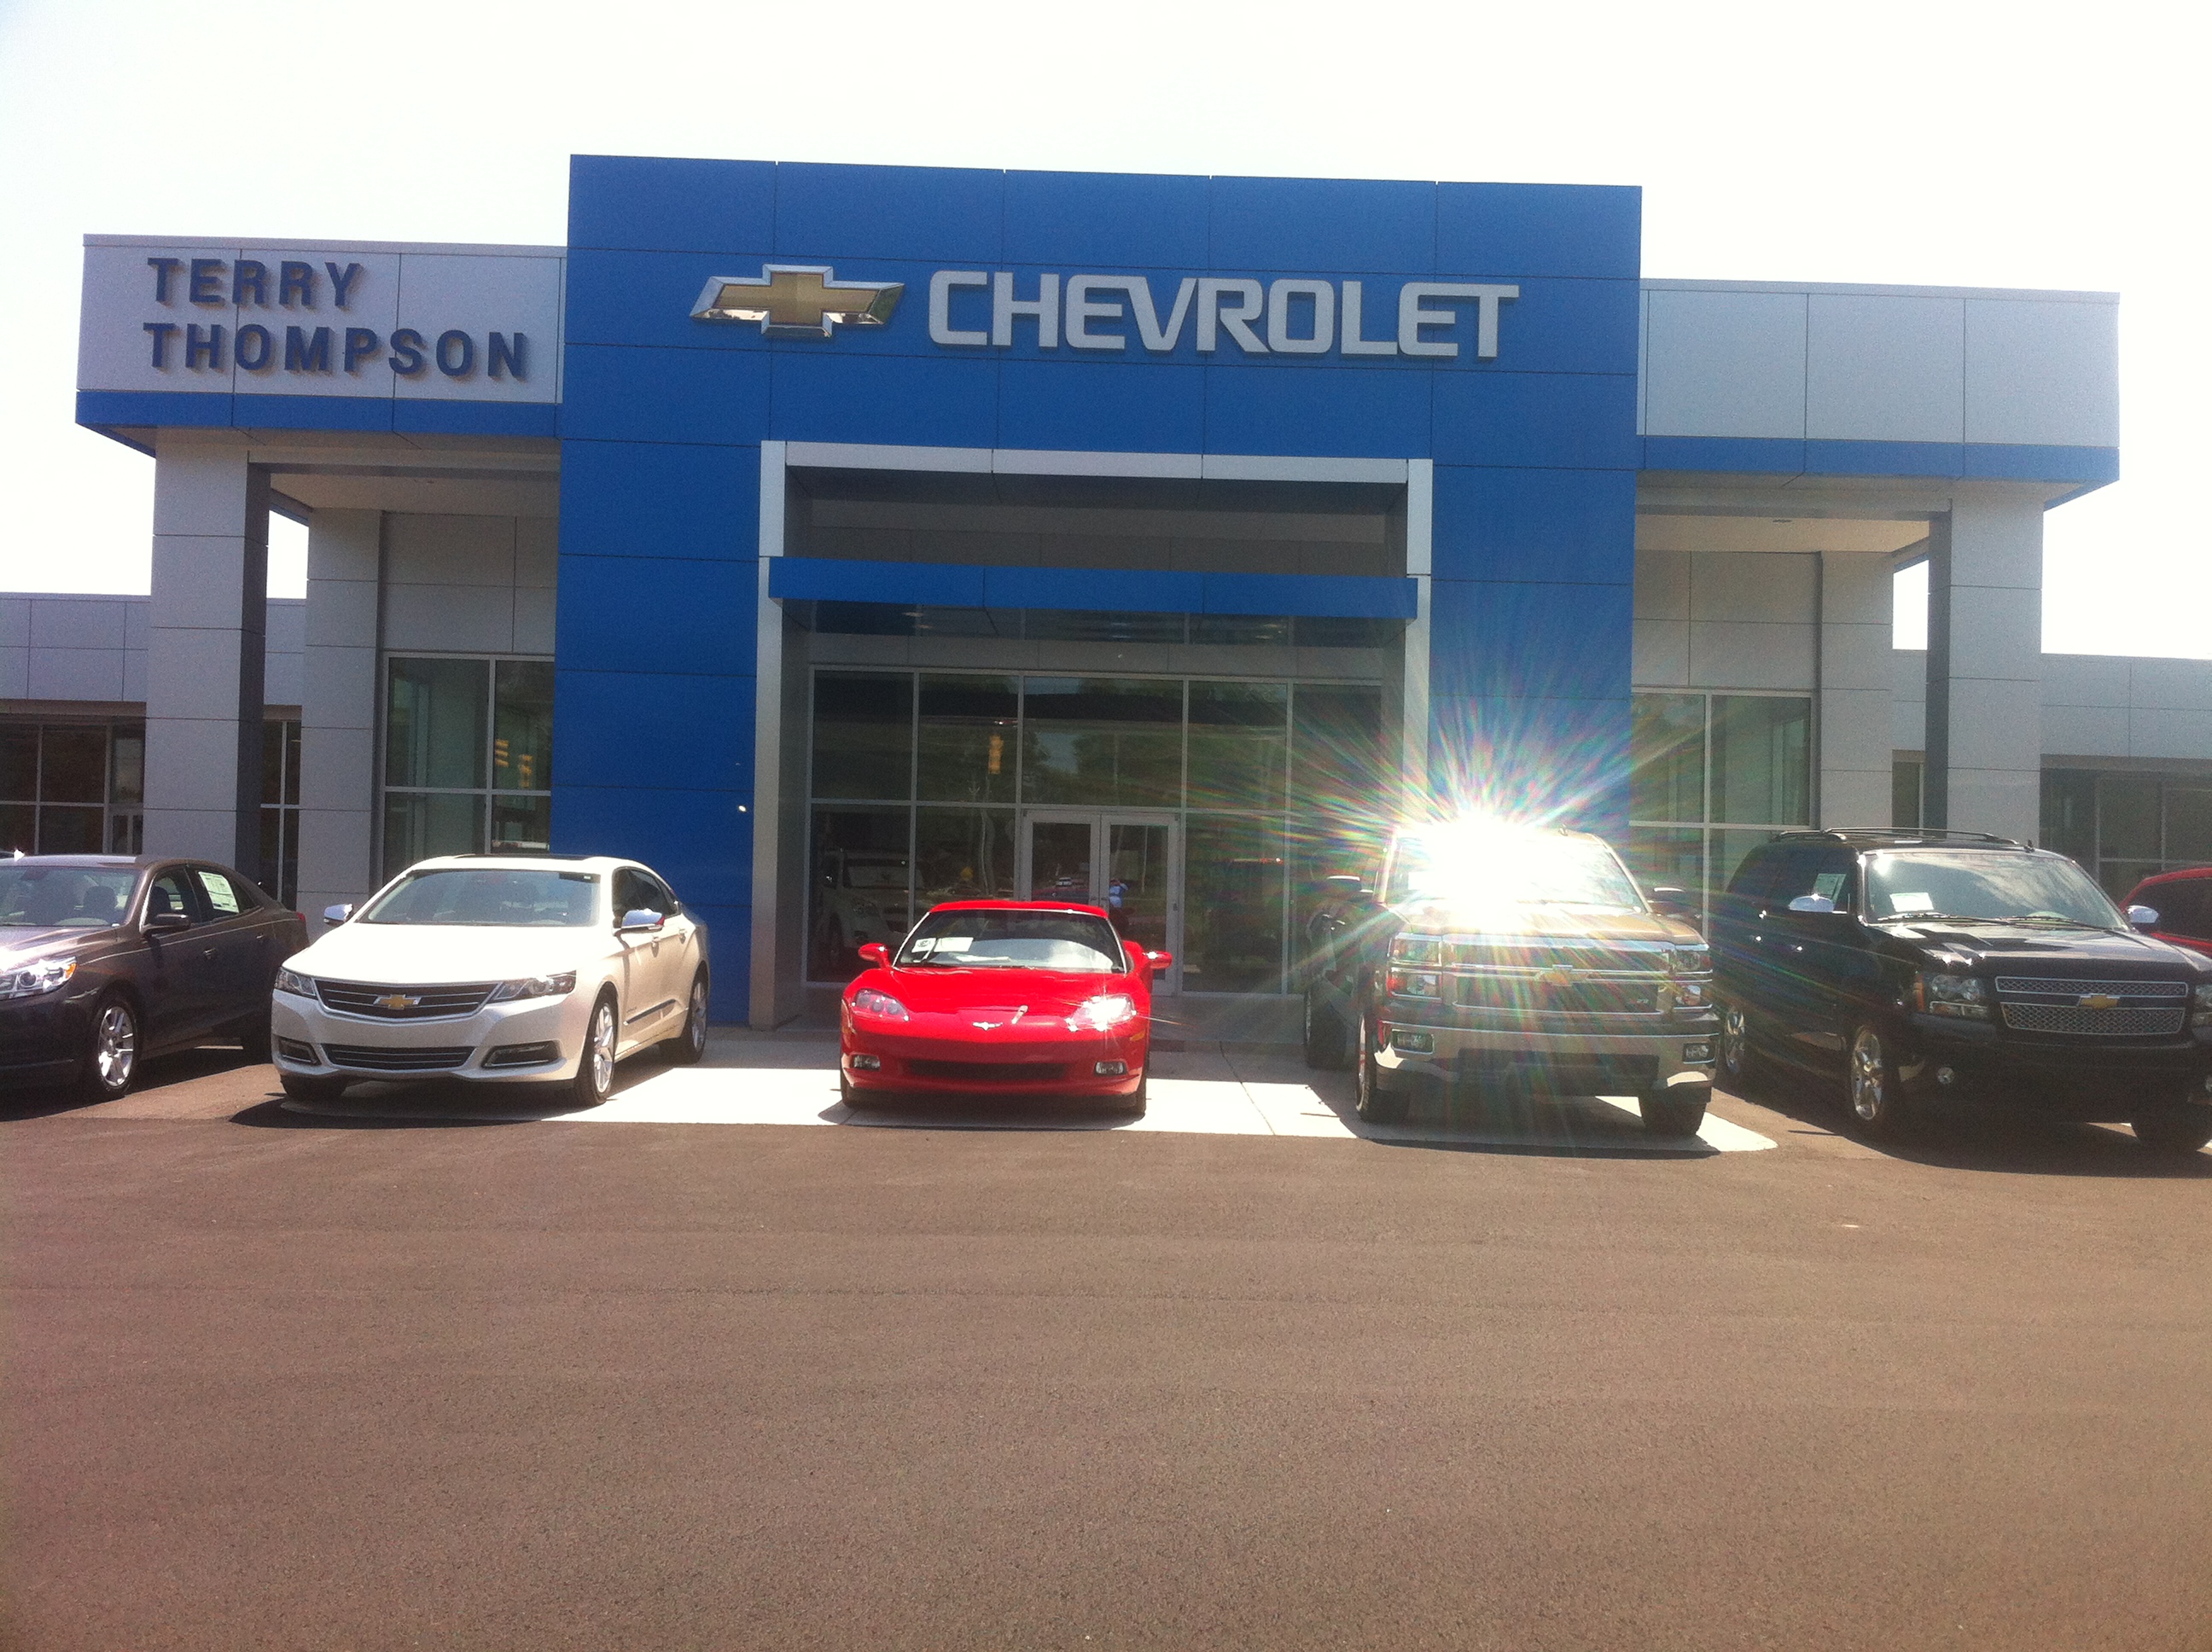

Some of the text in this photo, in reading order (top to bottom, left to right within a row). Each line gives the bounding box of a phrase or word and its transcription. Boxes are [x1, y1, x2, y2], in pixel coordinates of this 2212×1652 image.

[147, 257, 362, 308] TERRY
[928, 270, 1520, 358] CHEVROLET
[143, 322, 528, 381] THOMPSON
